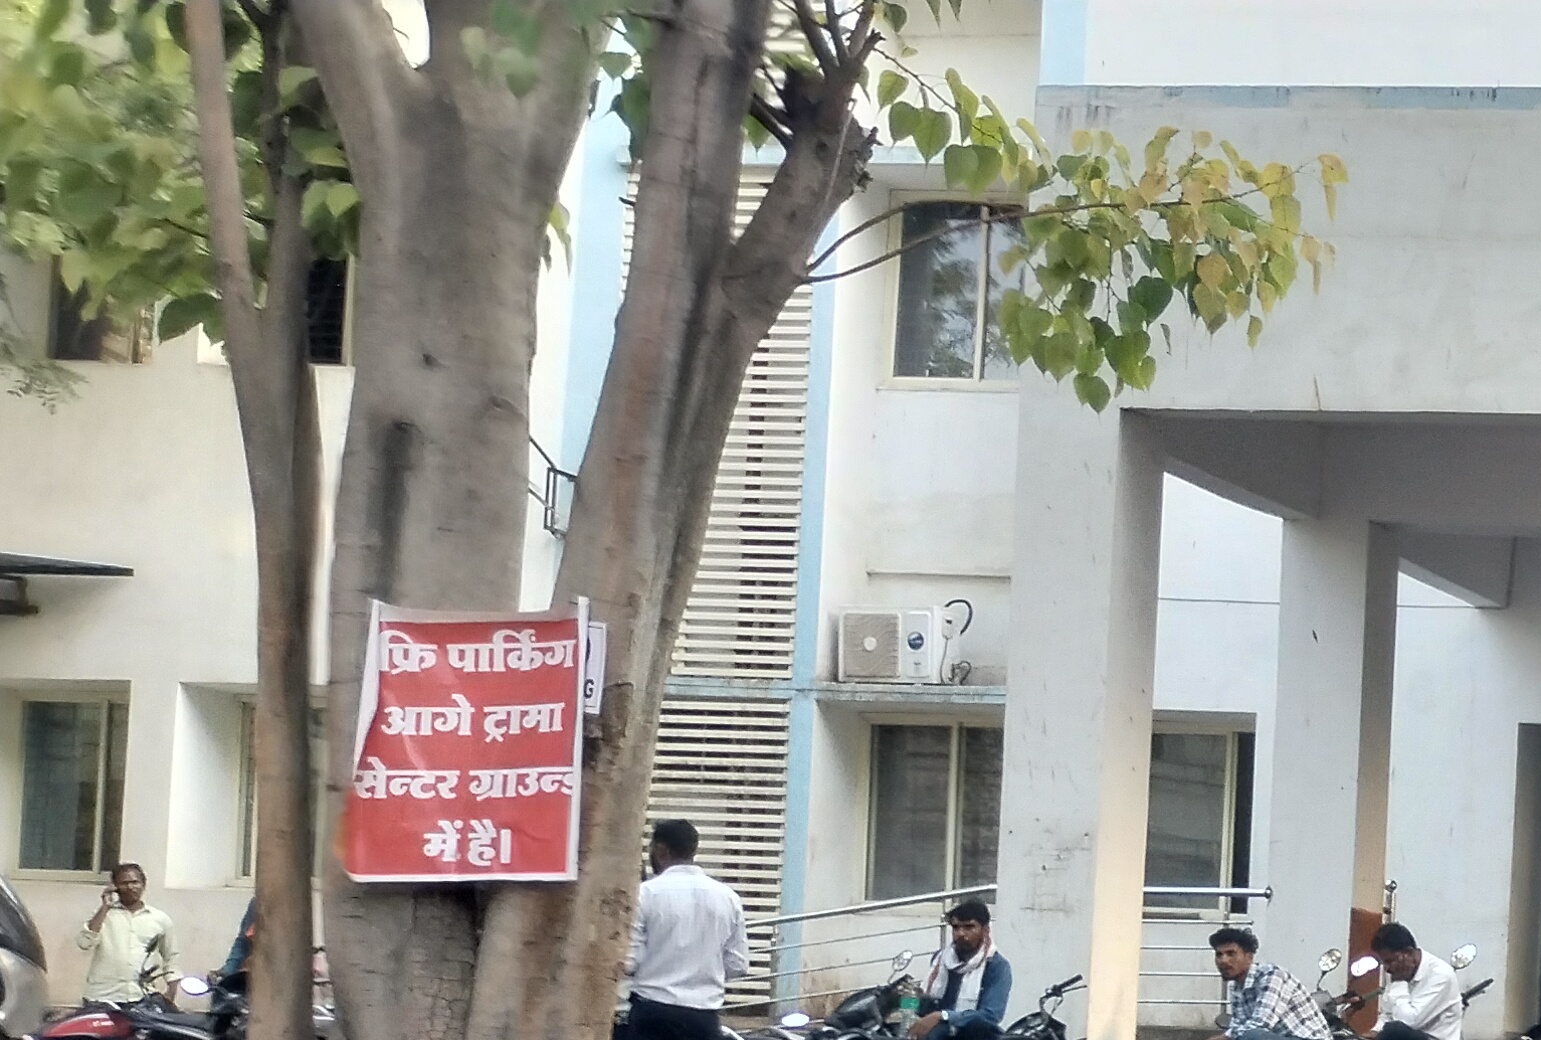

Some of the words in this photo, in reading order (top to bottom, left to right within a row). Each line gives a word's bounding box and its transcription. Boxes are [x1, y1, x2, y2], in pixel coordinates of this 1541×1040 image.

[446, 628, 577, 673] पार्किंग
[381, 693, 475, 736] आगे
[483, 701, 566, 742] ट्रामा
[354, 756, 460, 799] सेन्टर
[423, 819, 464, 862] में
